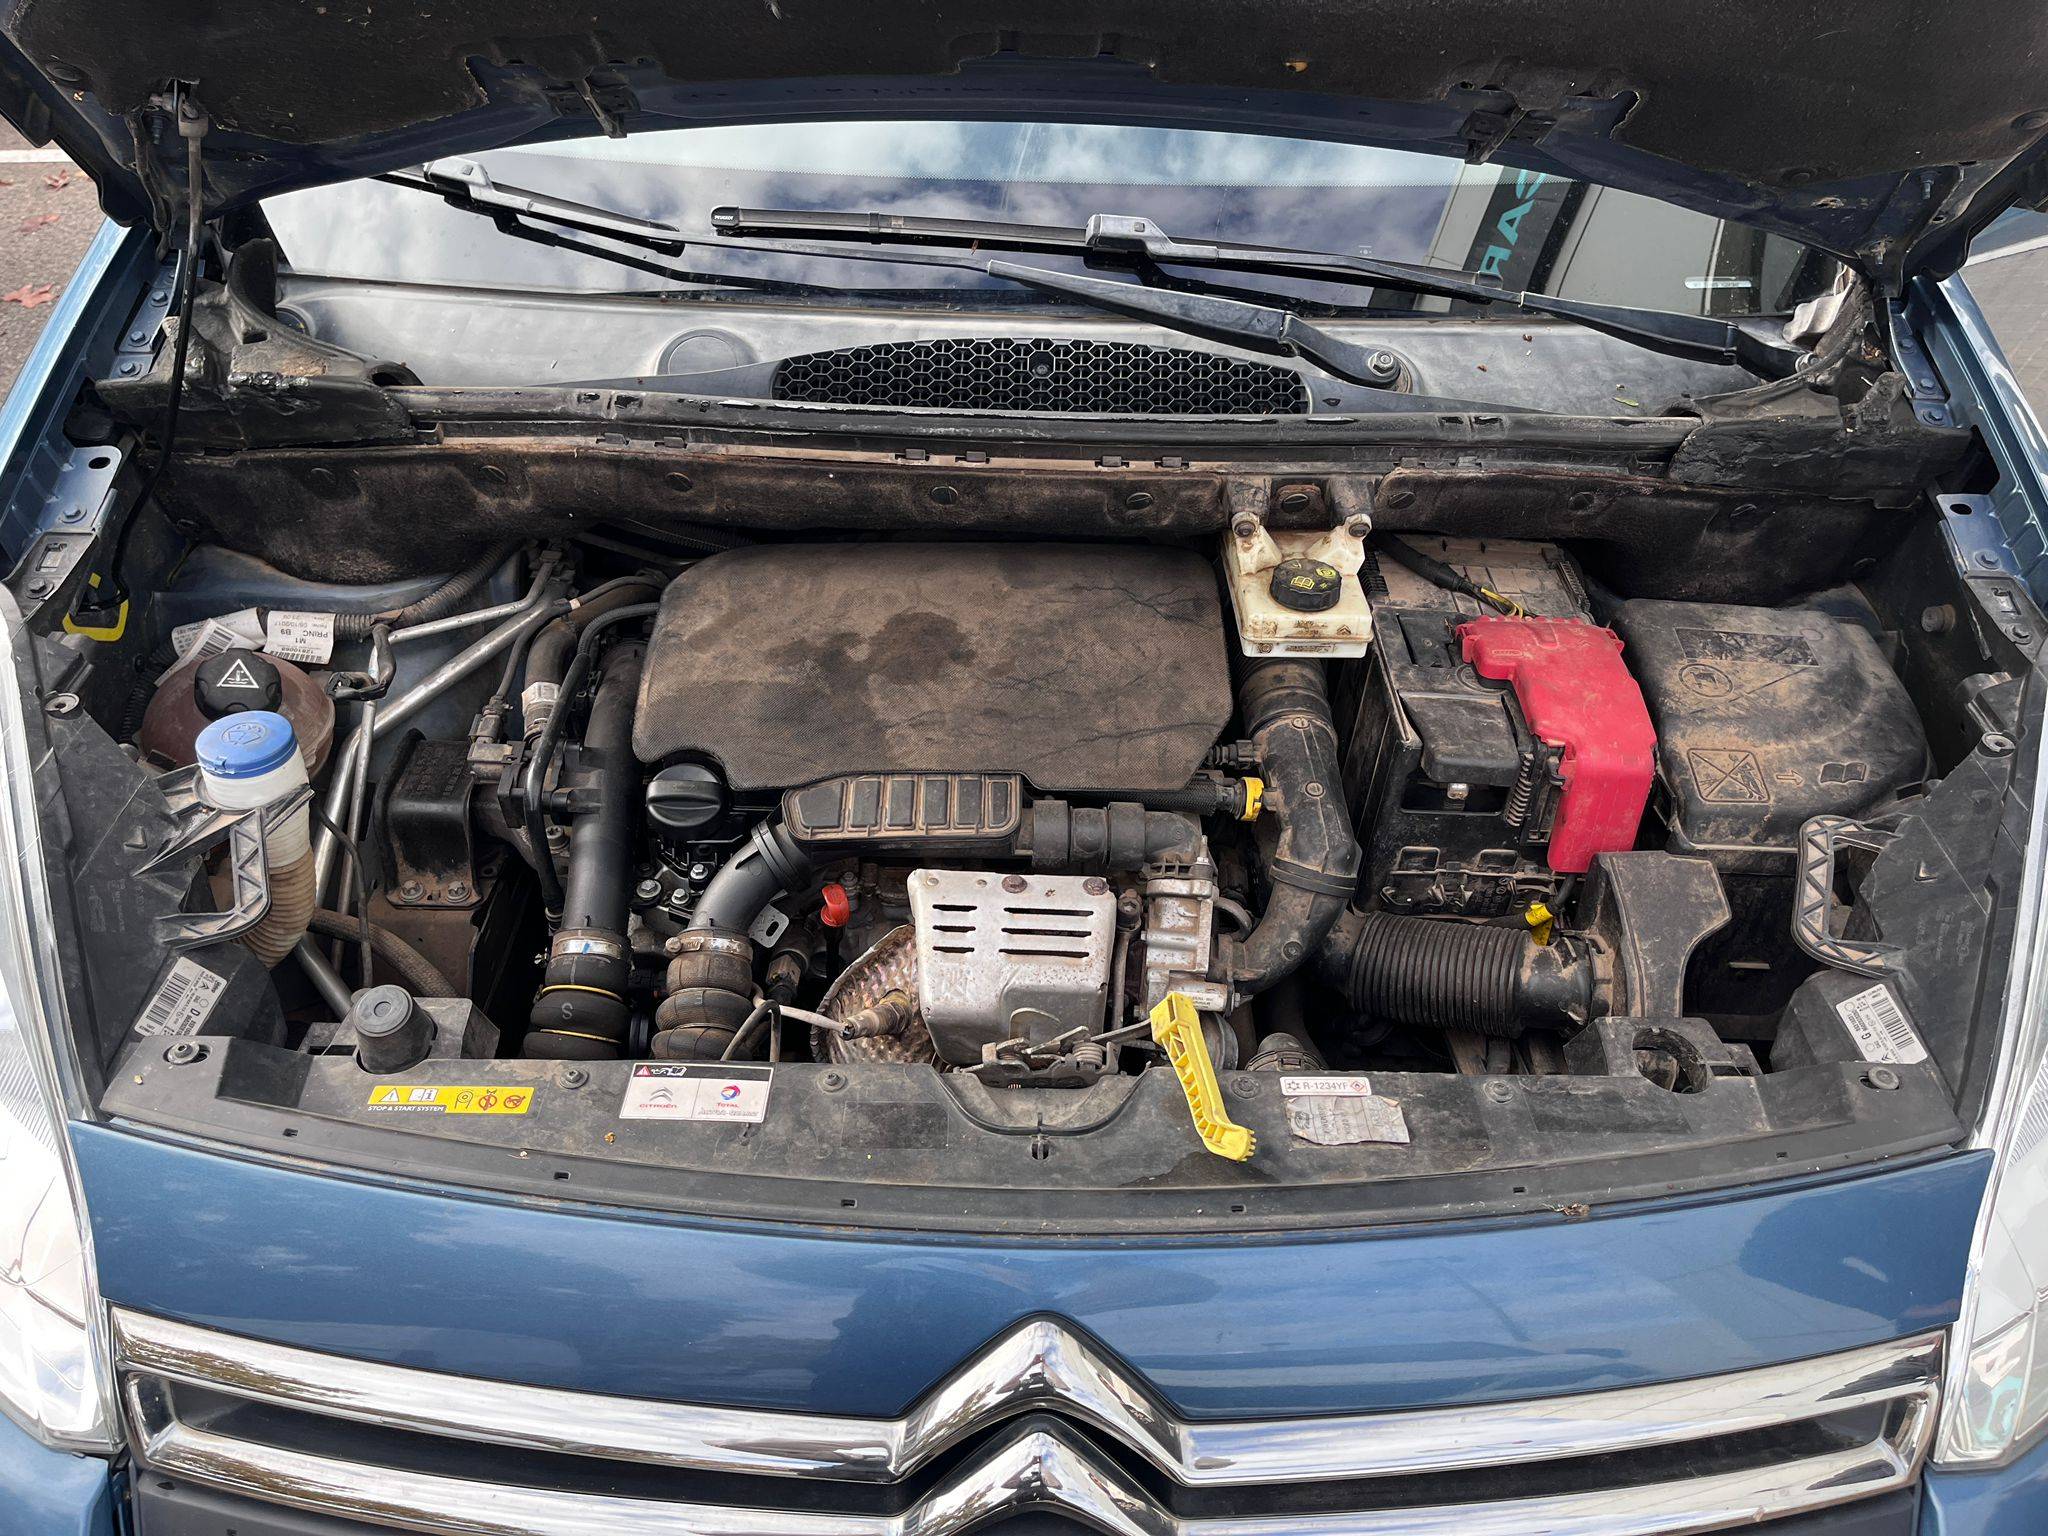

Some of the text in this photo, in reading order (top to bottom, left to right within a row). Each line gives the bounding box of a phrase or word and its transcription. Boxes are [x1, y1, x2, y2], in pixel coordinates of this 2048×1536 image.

[302, 629, 329, 639] PRINC
[191, 1008, 201, 1016] D
[561, 1002, 573, 1020] S
[1861, 1032, 1872, 1040] G
